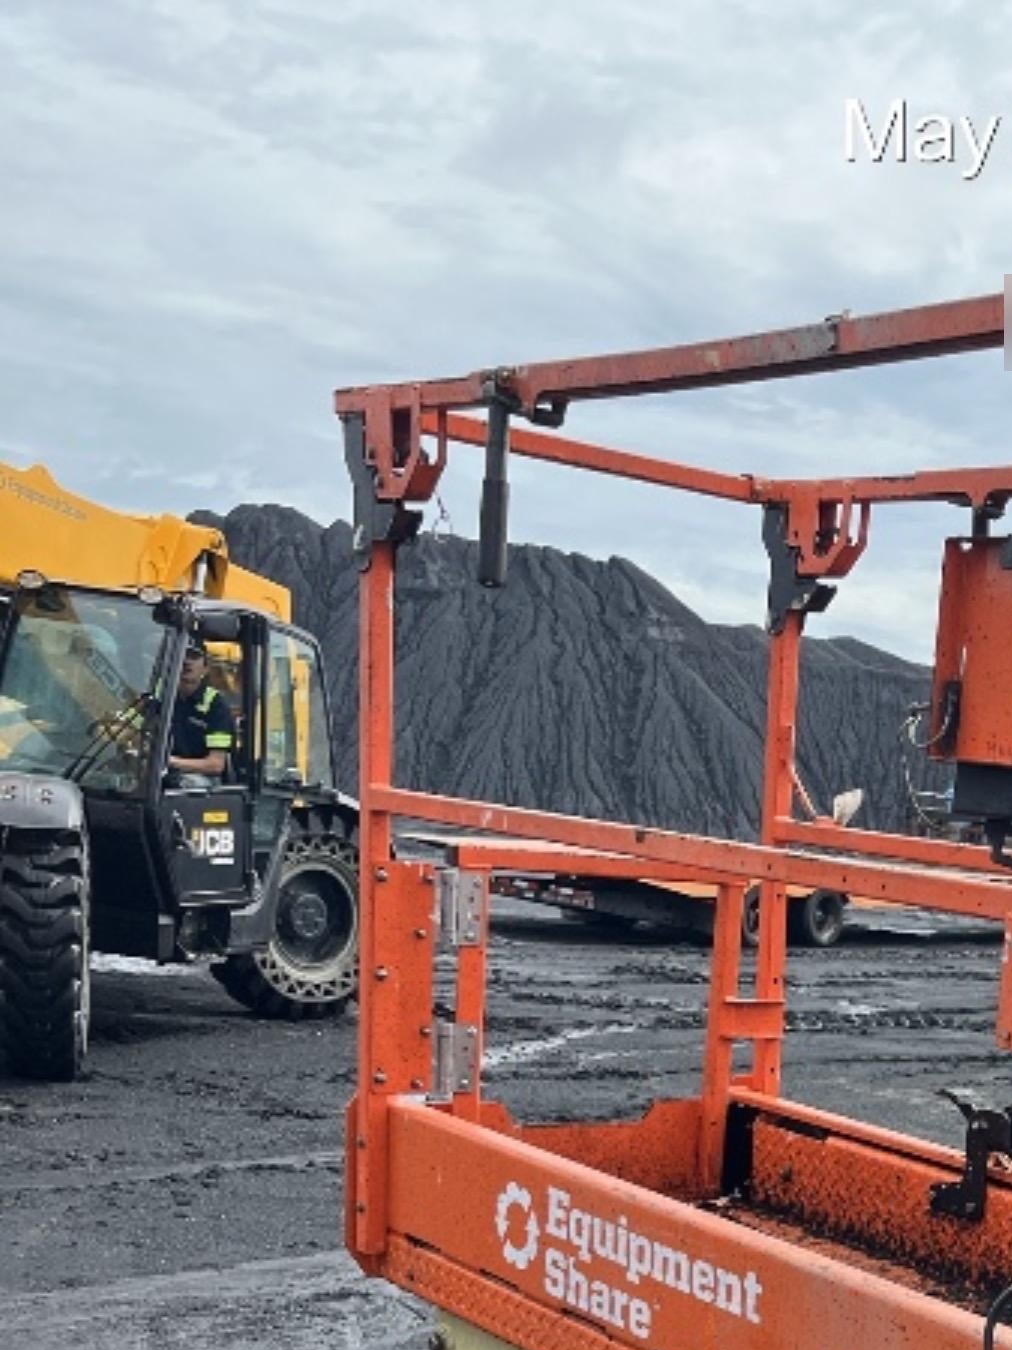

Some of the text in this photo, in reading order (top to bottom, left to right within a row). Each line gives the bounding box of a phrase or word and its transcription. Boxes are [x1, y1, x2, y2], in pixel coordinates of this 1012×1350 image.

[191, 828, 235, 856] JCB
[543, 1247, 652, 1339] Share
[545, 1184, 763, 1324] Equipment
